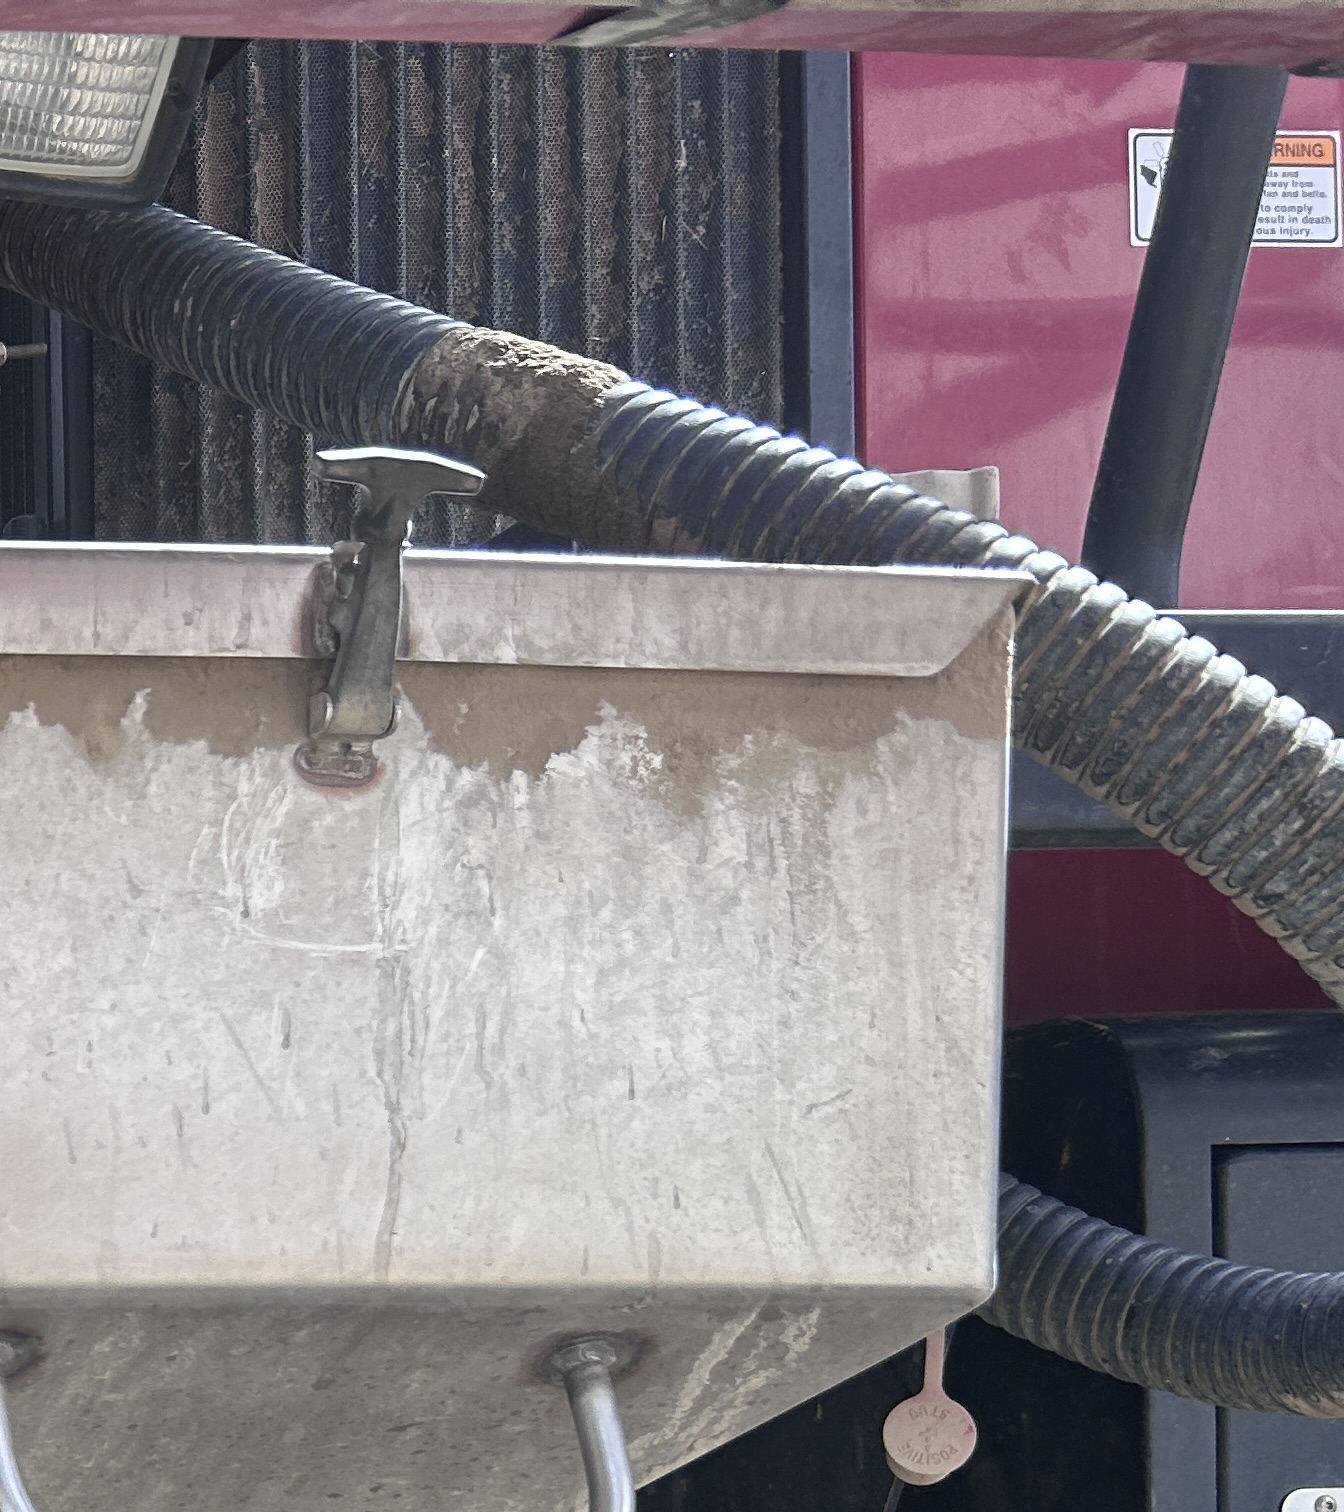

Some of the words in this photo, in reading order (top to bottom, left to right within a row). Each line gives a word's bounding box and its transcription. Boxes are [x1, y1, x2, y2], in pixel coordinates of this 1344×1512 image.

[1272, 142, 1324, 158] RNING
[1274, 204, 1313, 215] comply
[1257, 215, 1286, 224] esult
[1288, 215, 1298, 224] in
[1302, 215, 1332, 224] death
